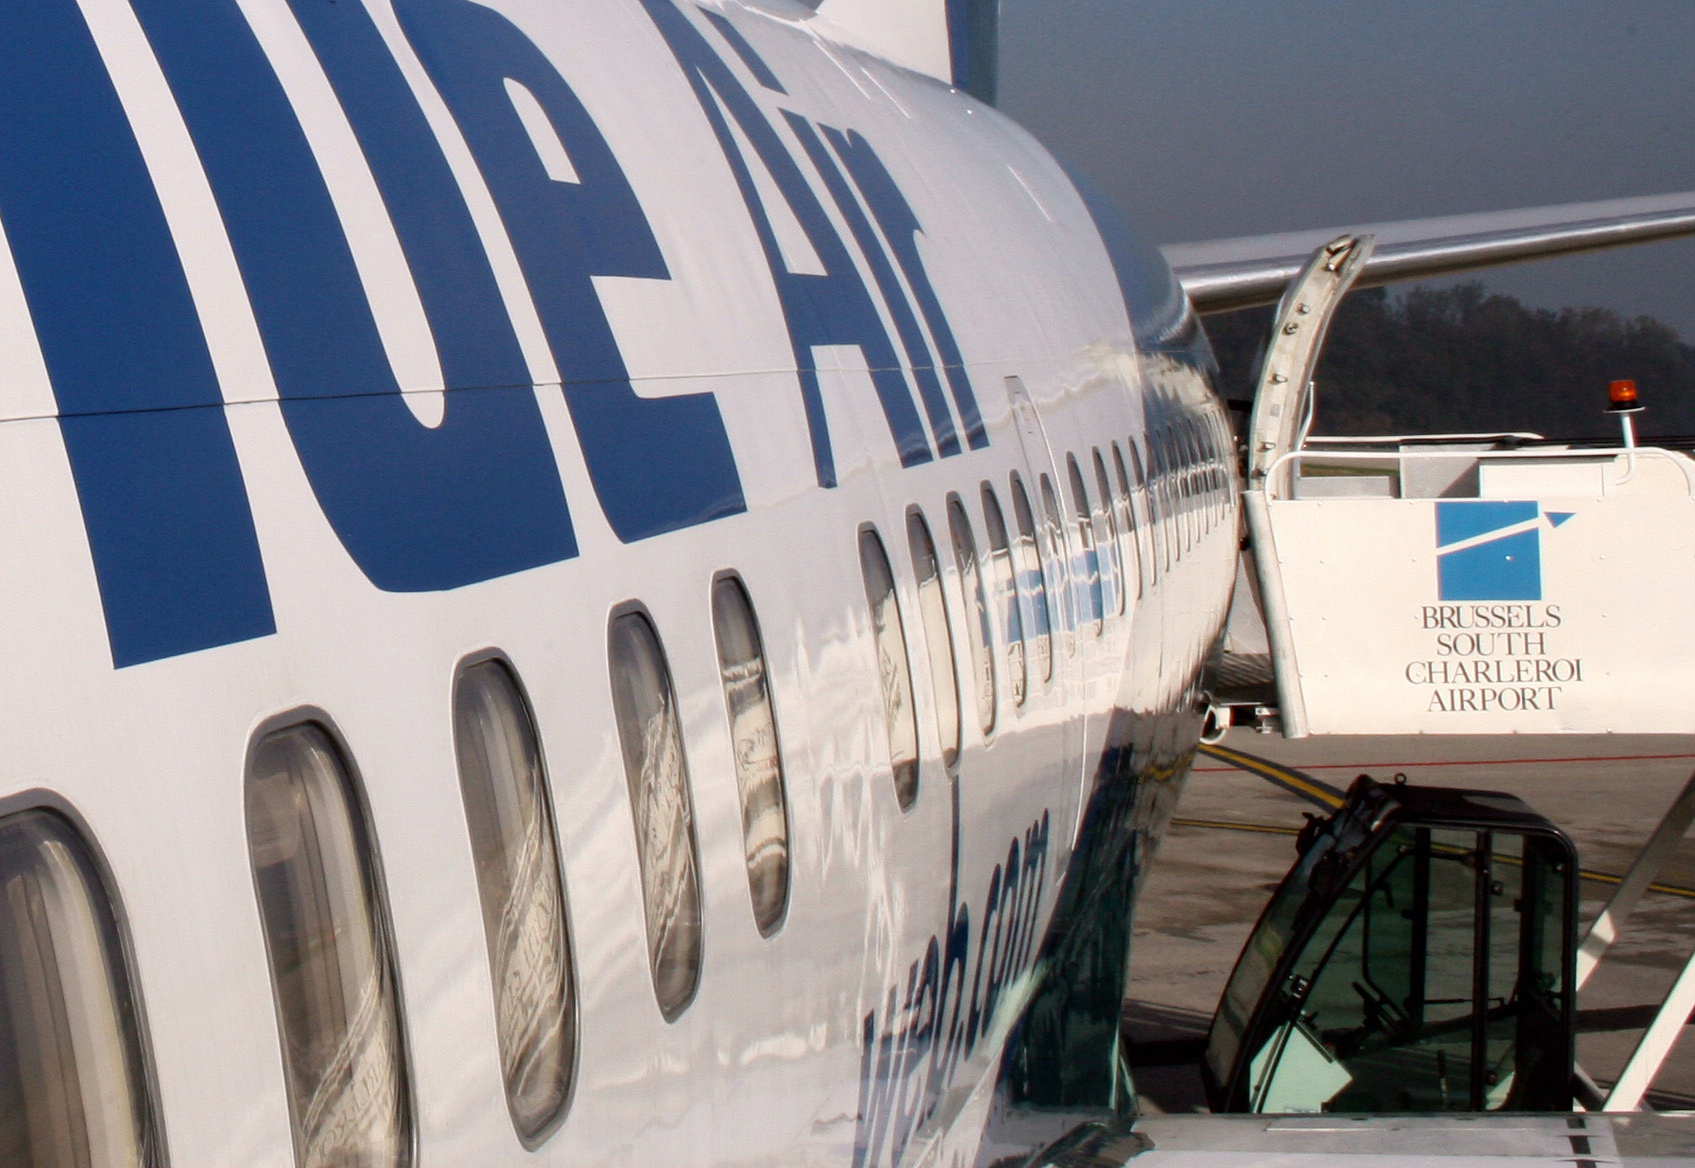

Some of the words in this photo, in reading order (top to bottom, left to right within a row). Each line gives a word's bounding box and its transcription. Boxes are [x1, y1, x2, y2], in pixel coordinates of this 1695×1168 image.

[1421, 605, 1562, 629] BRUSSELS
[1436, 632, 1546, 656] SOUTH
[1405, 659, 1583, 684] CHARLEROI
[1428, 686, 1562, 712] AIRPORT
